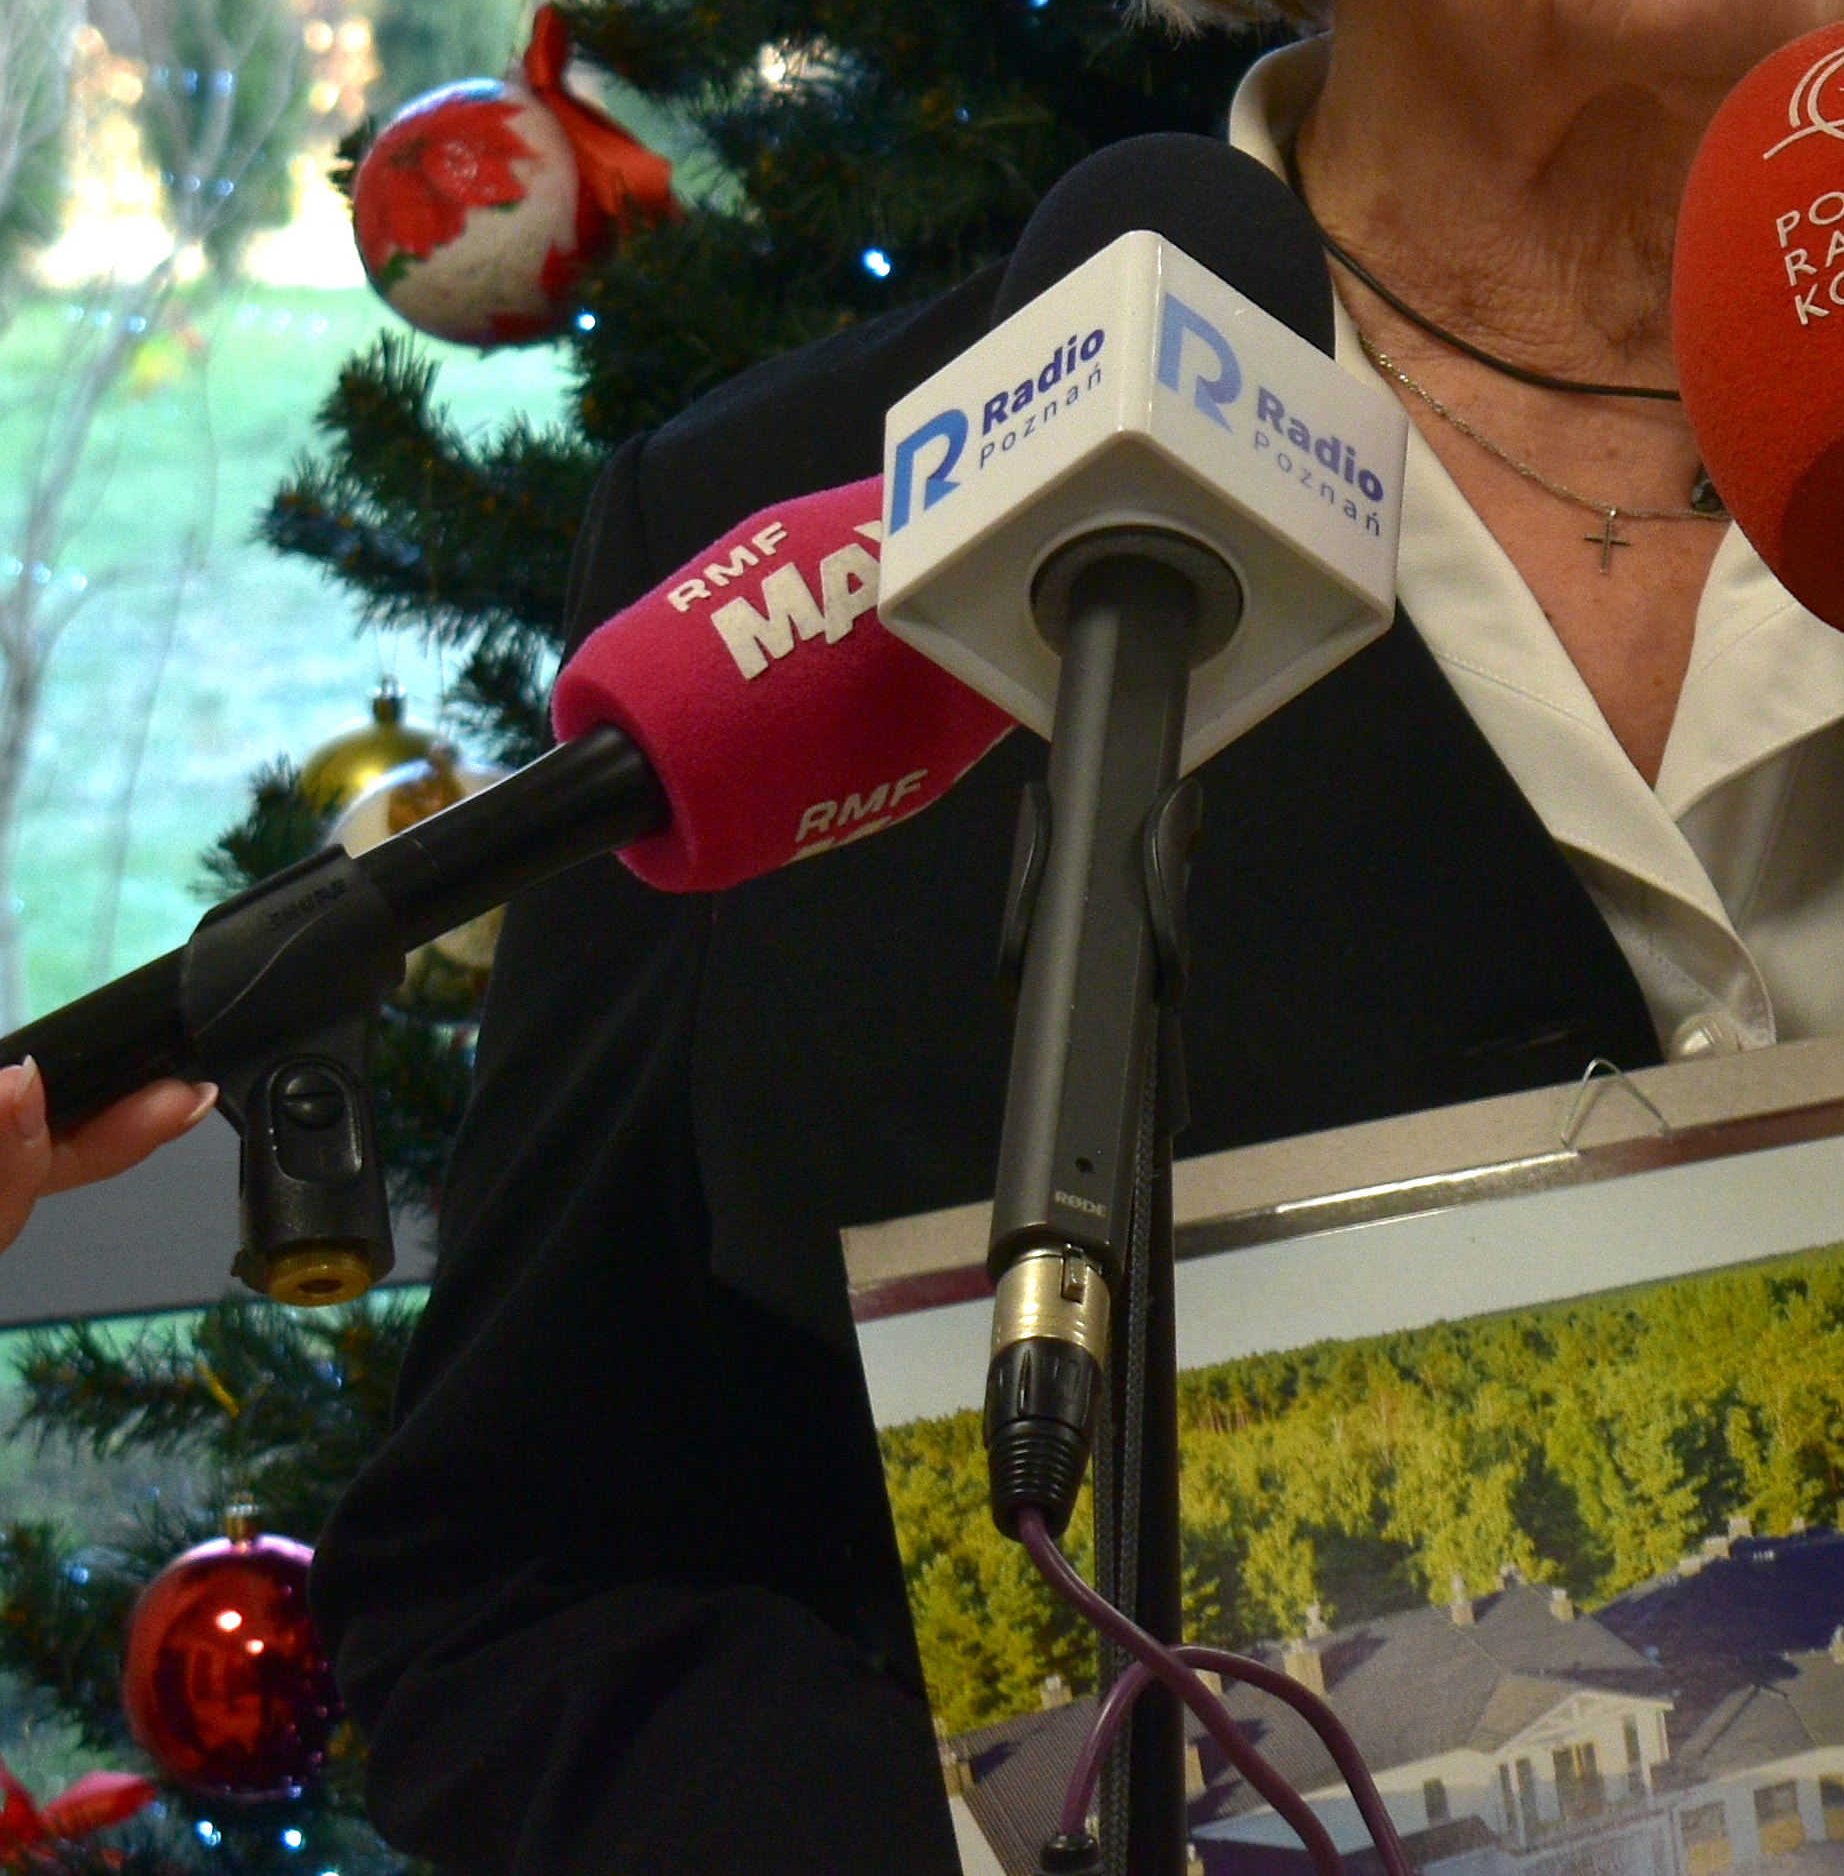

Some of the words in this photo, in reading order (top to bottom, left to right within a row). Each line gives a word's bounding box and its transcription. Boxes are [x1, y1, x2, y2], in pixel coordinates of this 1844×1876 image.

[979, 361, 1103, 470] Poznań
[981, 328, 1106, 437] Radio
[1253, 429, 1381, 537] Poznań
[1256, 384, 1385, 504] Radio
[666, 520, 788, 613] RMF
[709, 519, 882, 683] MA
[794, 768, 930, 843] RMF
